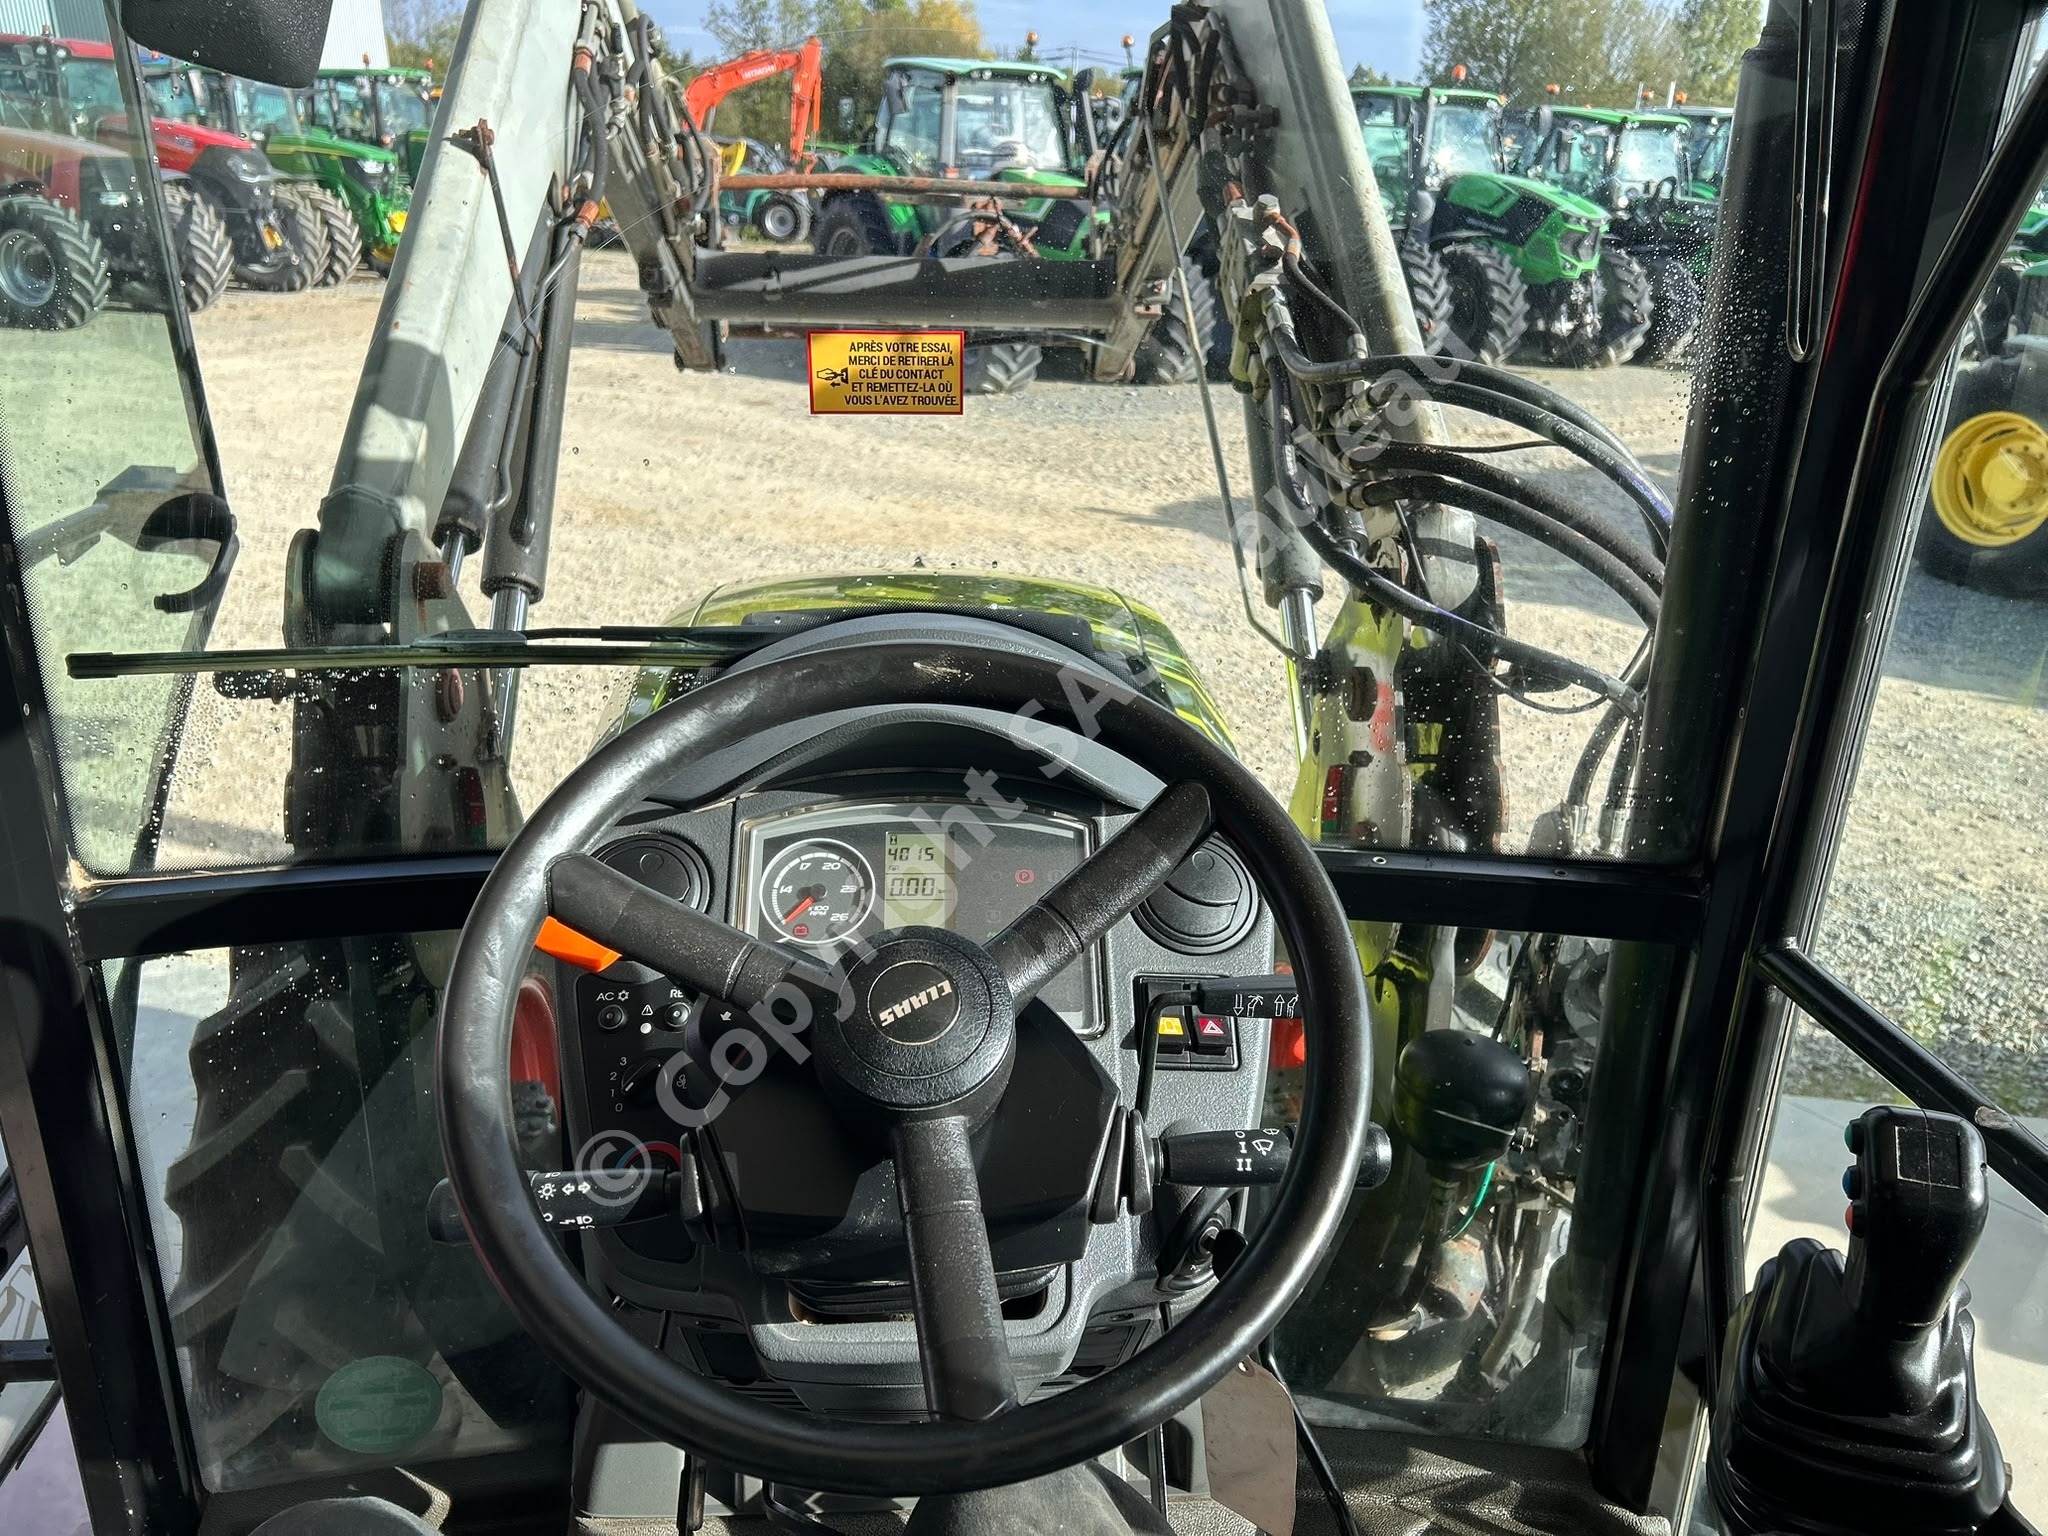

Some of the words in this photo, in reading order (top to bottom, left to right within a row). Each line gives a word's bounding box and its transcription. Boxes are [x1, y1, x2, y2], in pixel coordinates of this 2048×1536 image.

[849, 340, 883, 353] APRÈS
[885, 342, 919, 353] VOTRE
[921, 342, 953, 354] ESSAI,
[848, 356, 881, 366] MERCI
[883, 356, 896, 366] DE
[898, 356, 939, 366] RETIRER
[941, 356, 954, 366] LA
[859, 367, 877, 379] CLÉ
[880, 369, 894, 379] DU
[896, 369, 944, 379] CONTACT
[851, 382, 864, 392] ET
[866, 382, 936, 392] REMETTEZ-LA
[938, 380, 953, 393] OÙ
[844, 395, 873, 406] VOUS
[874, 395, 909, 406] L'AVEZ
[911, 394, 959, 406] TROUVÉE.
[888, 847, 934, 861] 4015
[800, 862, 812, 870] 17
[822, 862, 841, 870] 20
[779, 885, 793, 893] 14
[840, 885, 857, 893] 23
[890, 878, 935, 896] 0.00
[830, 913, 849, 921] 26
[597, 992, 615, 1001] AC
[879, 979, 952, 1027] CLAAS
[620, 1057, 627, 1066] 3
[610, 1072, 617, 1081] 2
[610, 1089, 615, 1097] 1
